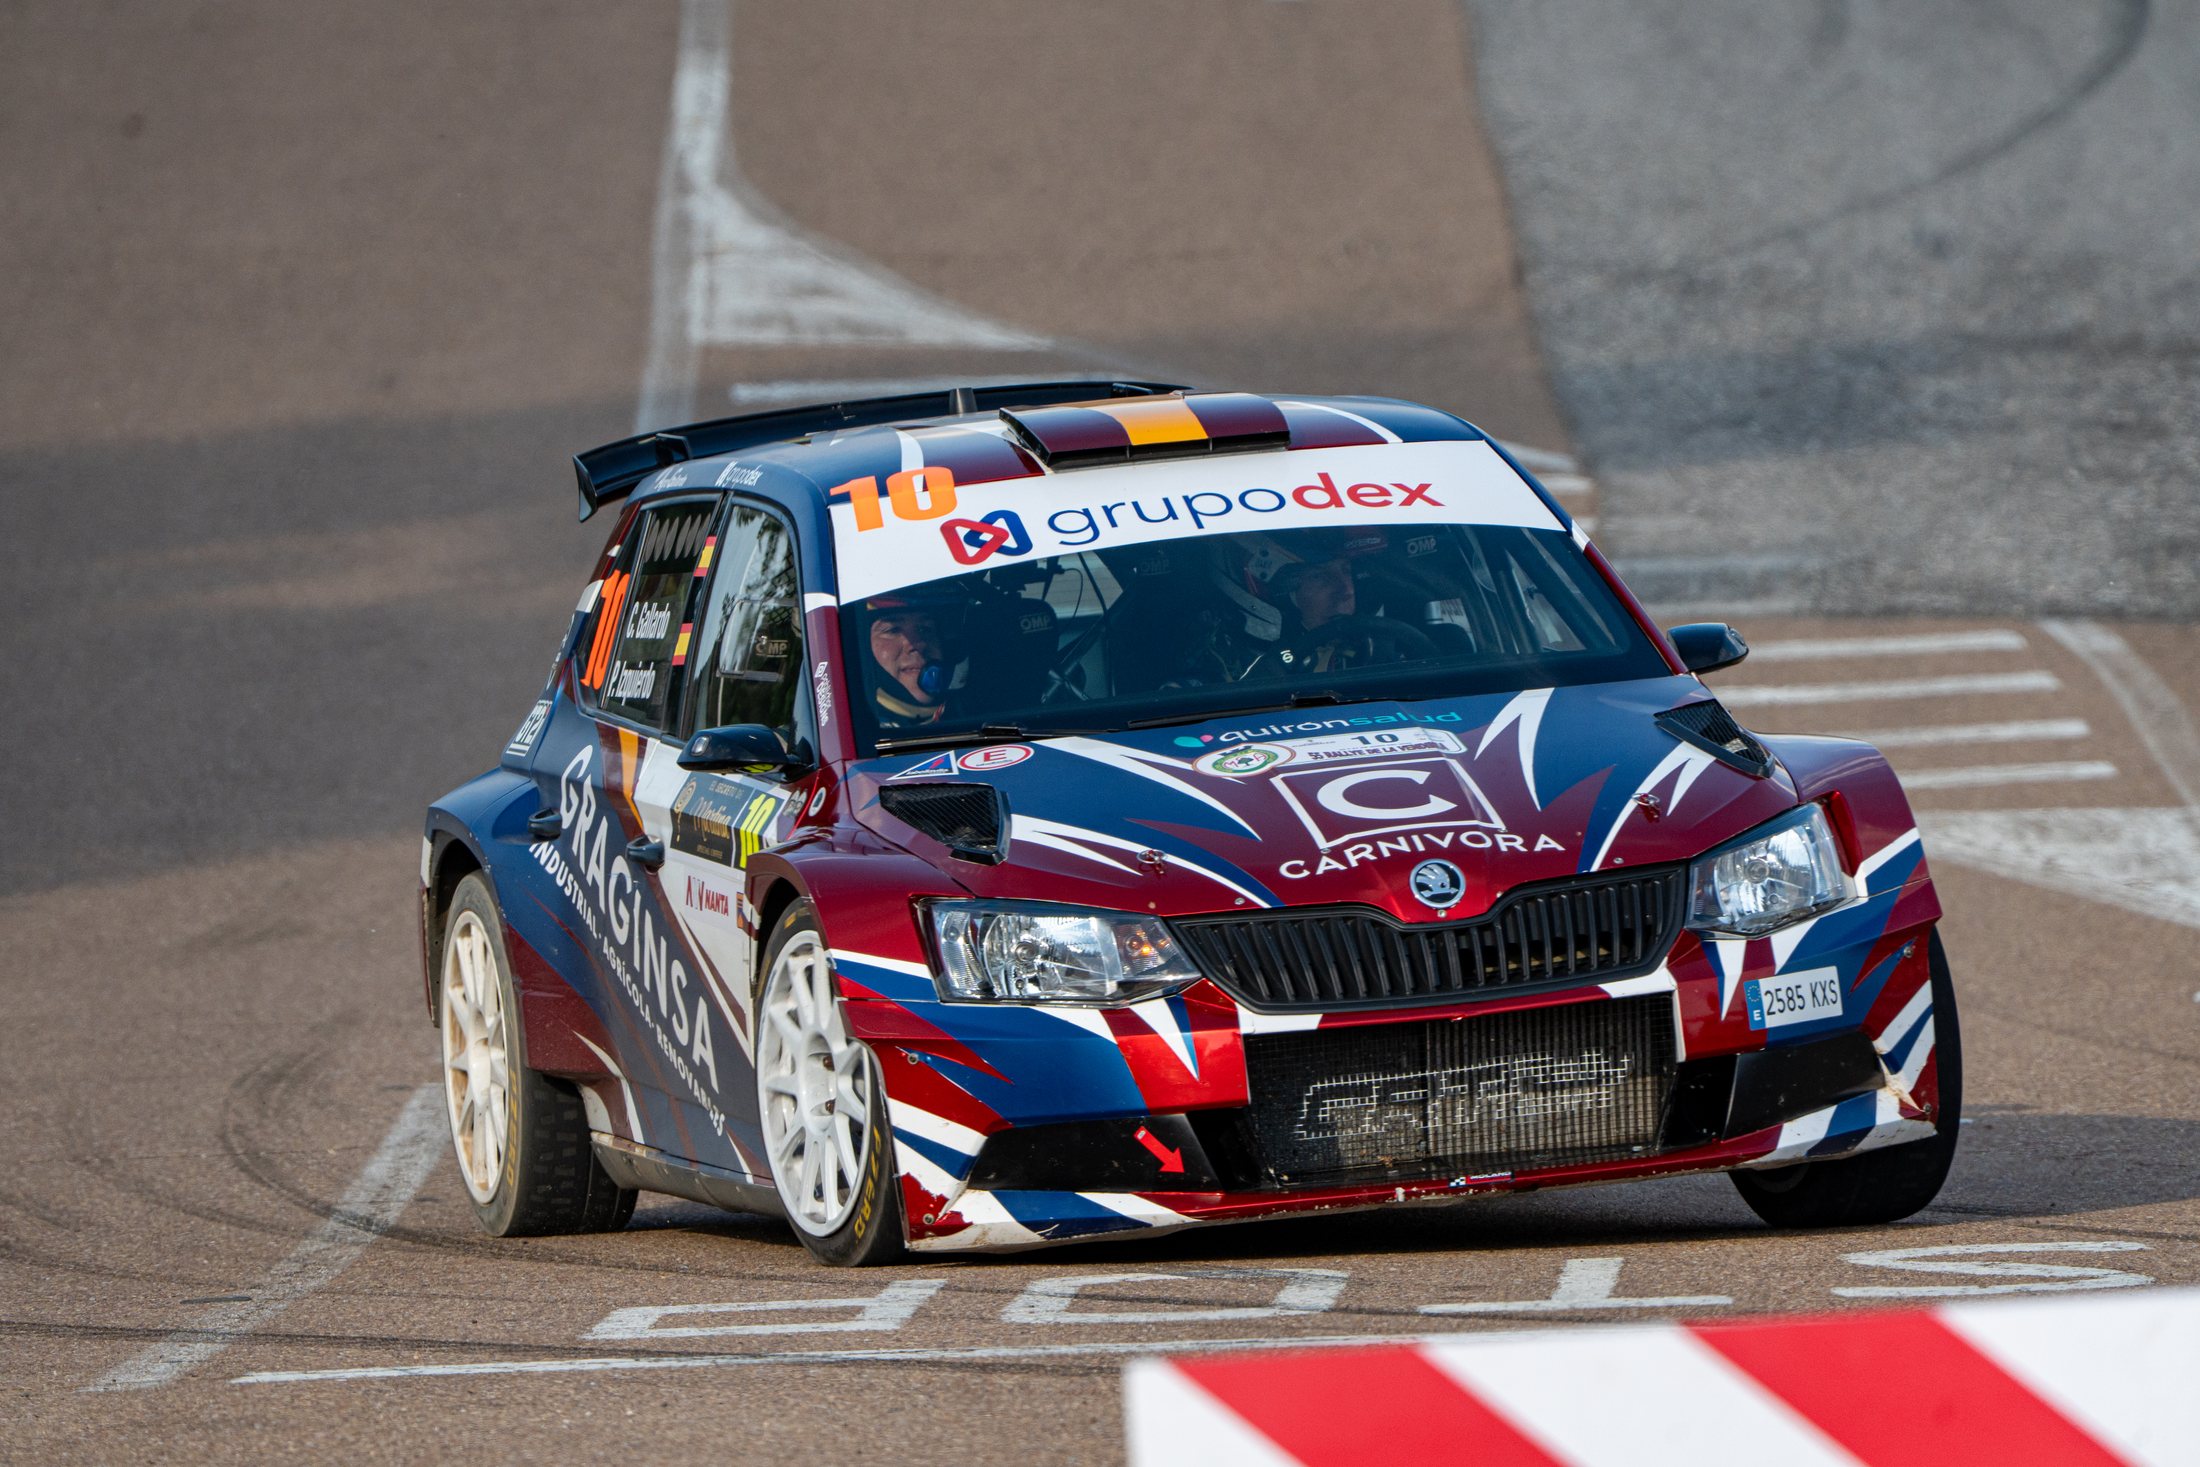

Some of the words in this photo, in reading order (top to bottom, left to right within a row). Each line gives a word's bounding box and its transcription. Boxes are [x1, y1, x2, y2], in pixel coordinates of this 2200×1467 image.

[830, 466, 958, 532] 10
[1047, 472, 1446, 546] grupodex
[1407, 538, 1437, 554] OMP
[580, 569, 631, 690] 10
[626, 601, 638, 639] C.
[635, 601, 671, 640] Gallardo
[607, 660, 620, 697] P.
[983, 749, 1008, 763] E
[1324, 748, 1363, 759] RALLYE
[1363, 747, 1381, 755] DE
[1383, 746, 1399, 754] LA
[1351, 733, 1399, 745] 10
[1317, 769, 1459, 820] C
[738, 793, 777, 870] 10
[1278, 831, 1567, 880] CARNIVORA
[528, 840, 599, 940] INDUSTRIAL
[705, 889, 729, 917] NANTA
[560, 743, 719, 1095] GRAGINSA
[1753, 1009, 1762, 1021] E
[1764, 984, 1806, 1017] 2585
[1809, 979, 1839, 1009] KXS
[577, 1241, 2156, 1341] STOP
